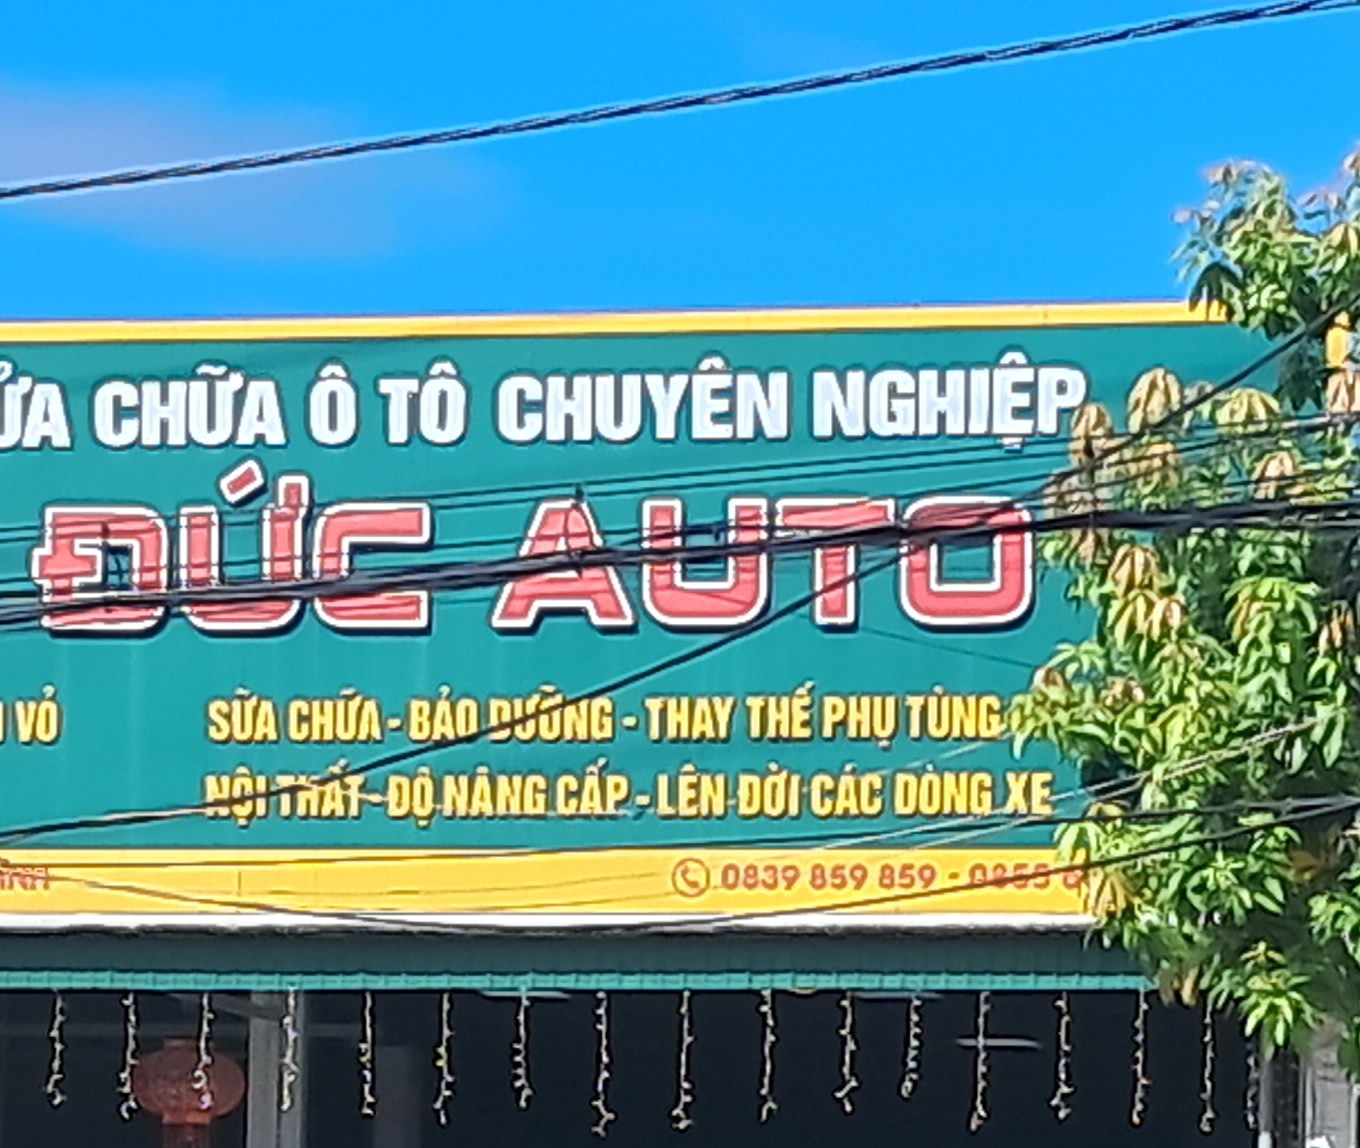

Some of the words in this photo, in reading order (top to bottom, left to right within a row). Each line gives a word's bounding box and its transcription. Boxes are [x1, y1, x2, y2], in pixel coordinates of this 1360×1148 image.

[92, 361, 287, 450] CHỮA
[308, 361, 357, 447] Ô
[379, 360, 467, 445] TÔ
[497, 355, 788, 442] CHUYÊN
[813, 350, 1086, 452] NGHIỆP
[30, 457, 433, 634] ĐỨC
[490, 494, 1036, 632] AUTO
[14, 685, 60, 743] VỎ
[408, 684, 478, 743] BẢO
[645, 697, 735, 742] THAY
[746, 681, 815, 740] THẾ
[822, 697, 897, 750] PHỤ
[204, 764, 269, 828] NỘI
[276, 758, 366, 819] THẤT
[387, 764, 435, 828] ĐỘ
[444, 764, 547, 817] NÂNG
[556, 756, 631, 817] CẤP
[656, 764, 728, 818] LÊN
[810, 762, 884, 817] CÁC
[1005, 772, 1054, 816] XE
[721, 863, 802, 890] 0839
[809, 863, 869, 890] 859
[879, 863, 938, 889] 859
